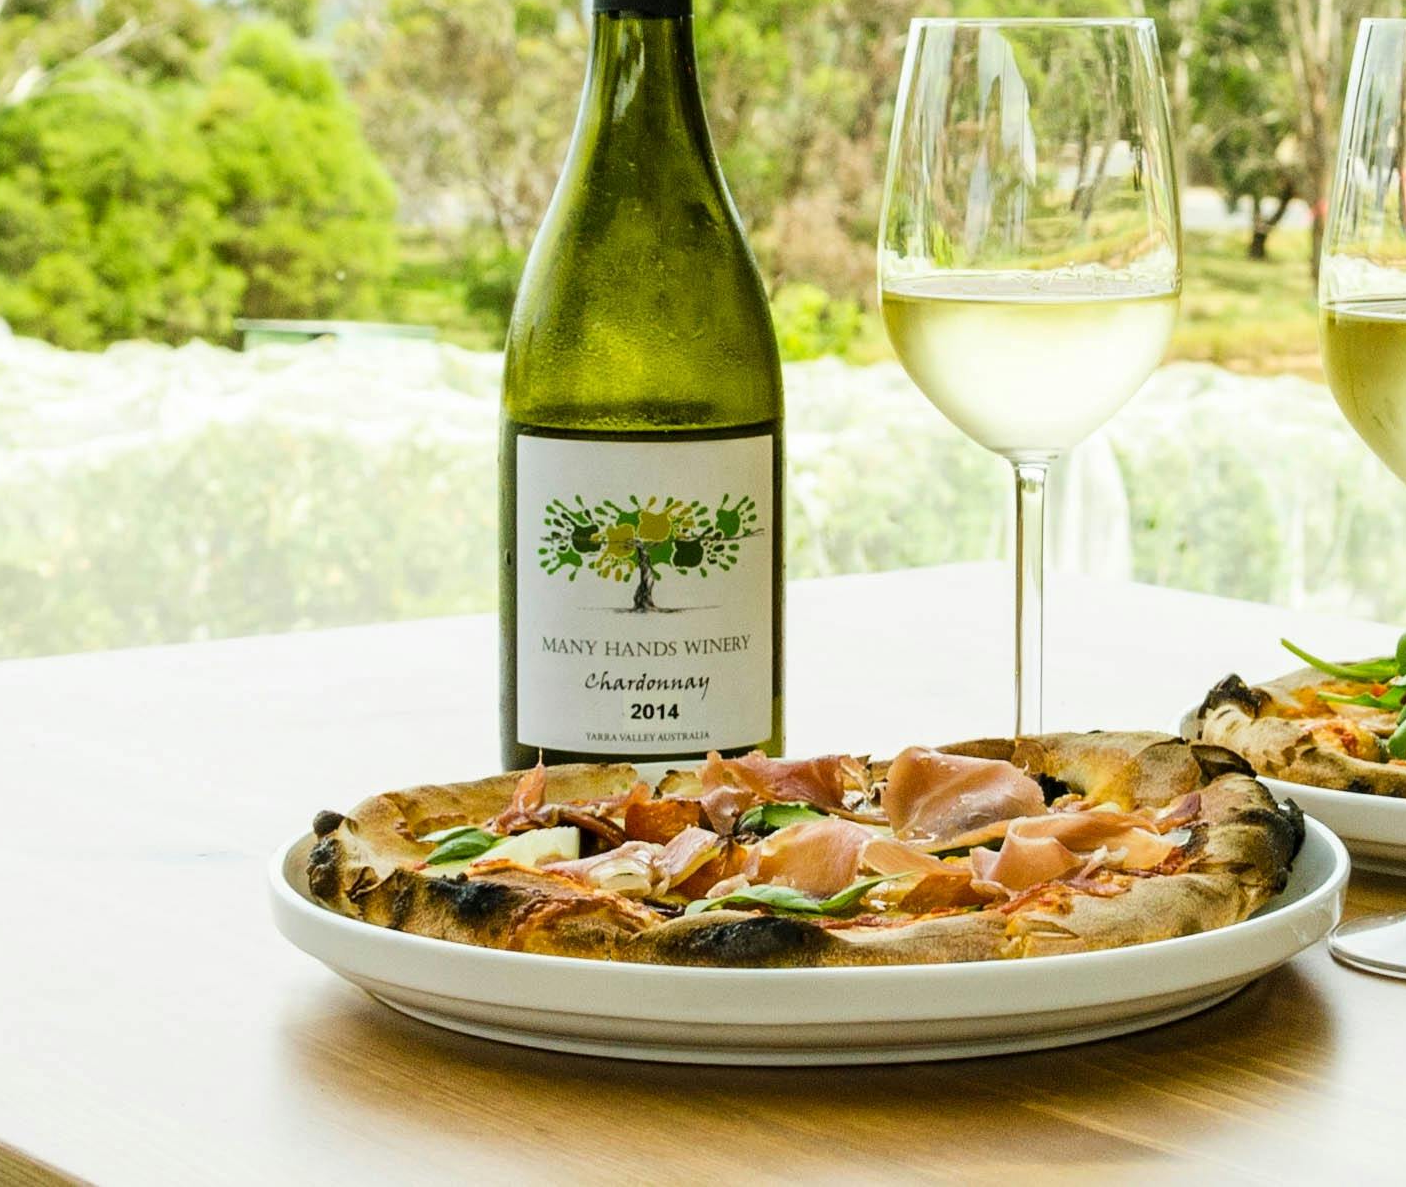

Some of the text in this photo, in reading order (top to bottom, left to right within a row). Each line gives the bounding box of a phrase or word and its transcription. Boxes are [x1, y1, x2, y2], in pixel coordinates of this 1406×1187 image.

[543, 634, 751, 657] MANY HANDS WINERY
[585, 671, 710, 700] Chardonnay
[631, 704, 680, 720] 2014
[586, 731, 710, 742] YARRA VALLEY AUSTRALIA
